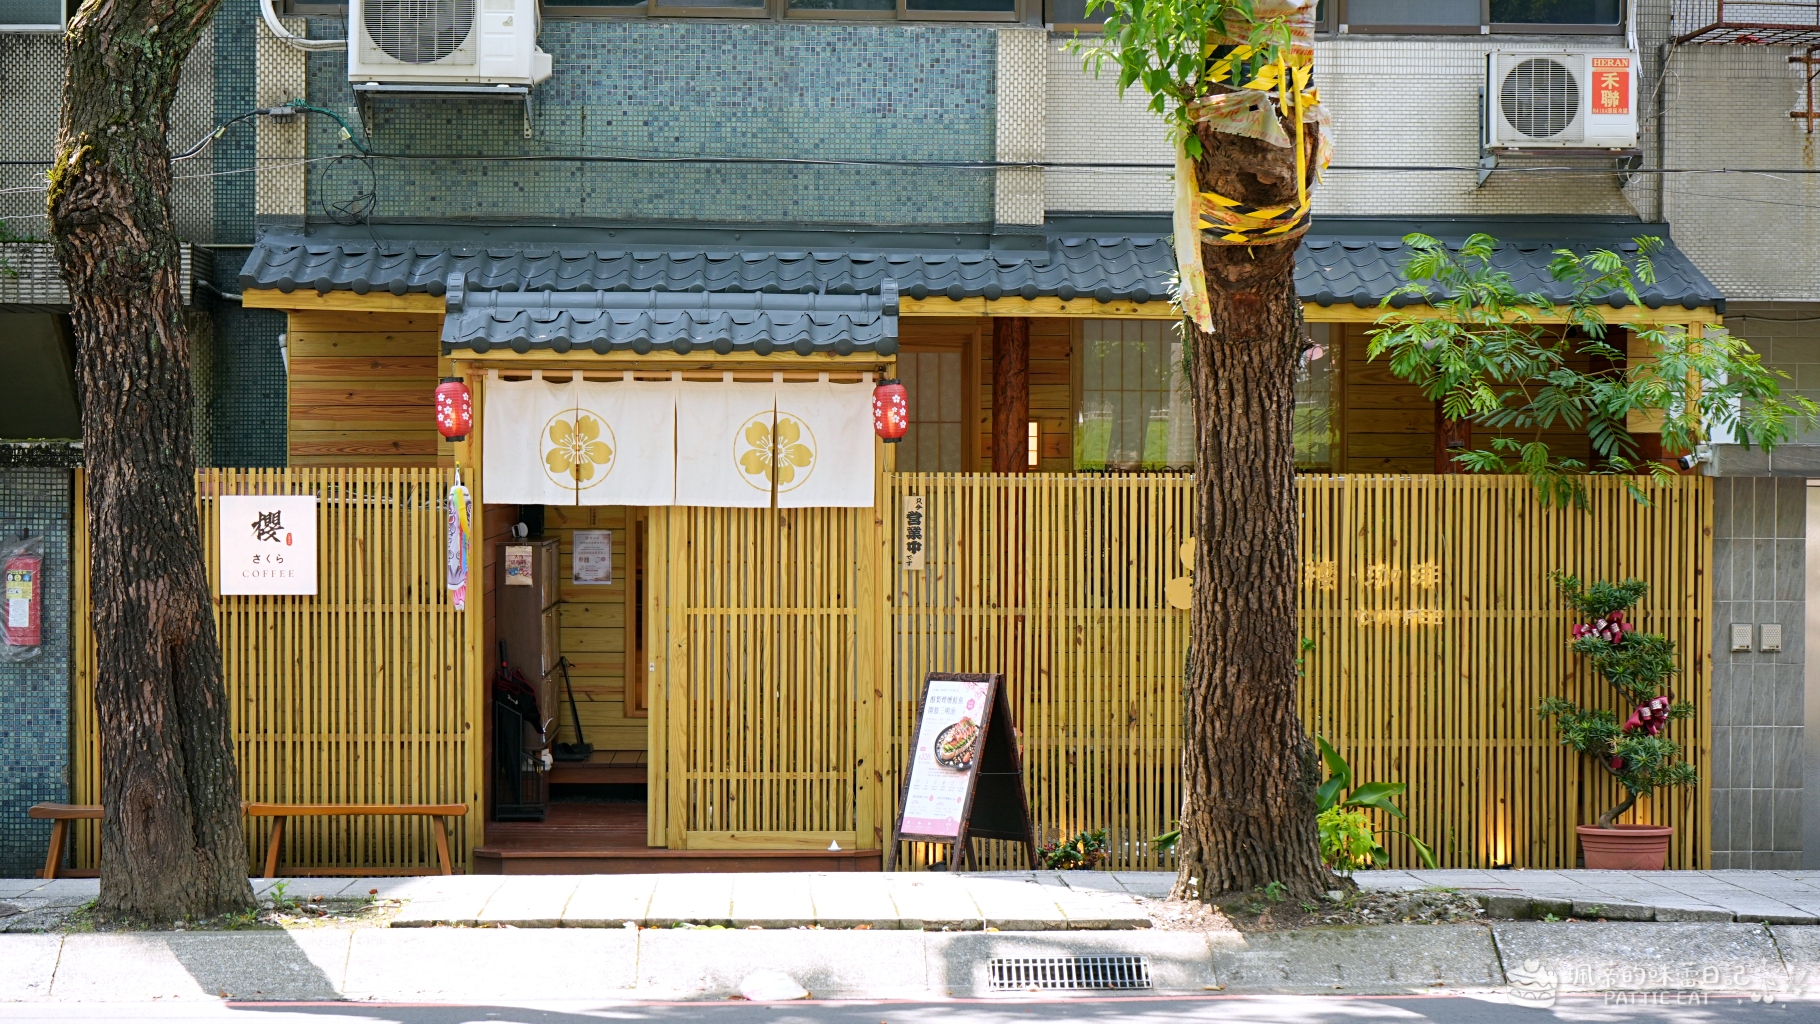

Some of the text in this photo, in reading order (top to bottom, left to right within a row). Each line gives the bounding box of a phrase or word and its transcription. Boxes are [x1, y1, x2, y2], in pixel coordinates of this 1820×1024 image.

[1601, 72, 1619, 107] 禾聯
[251, 509, 285, 543] 櫻
[252, 553, 284, 564] さくら
[242, 569, 294, 577] COFFEE
[1357, 608, 1443, 626] COFFEE
